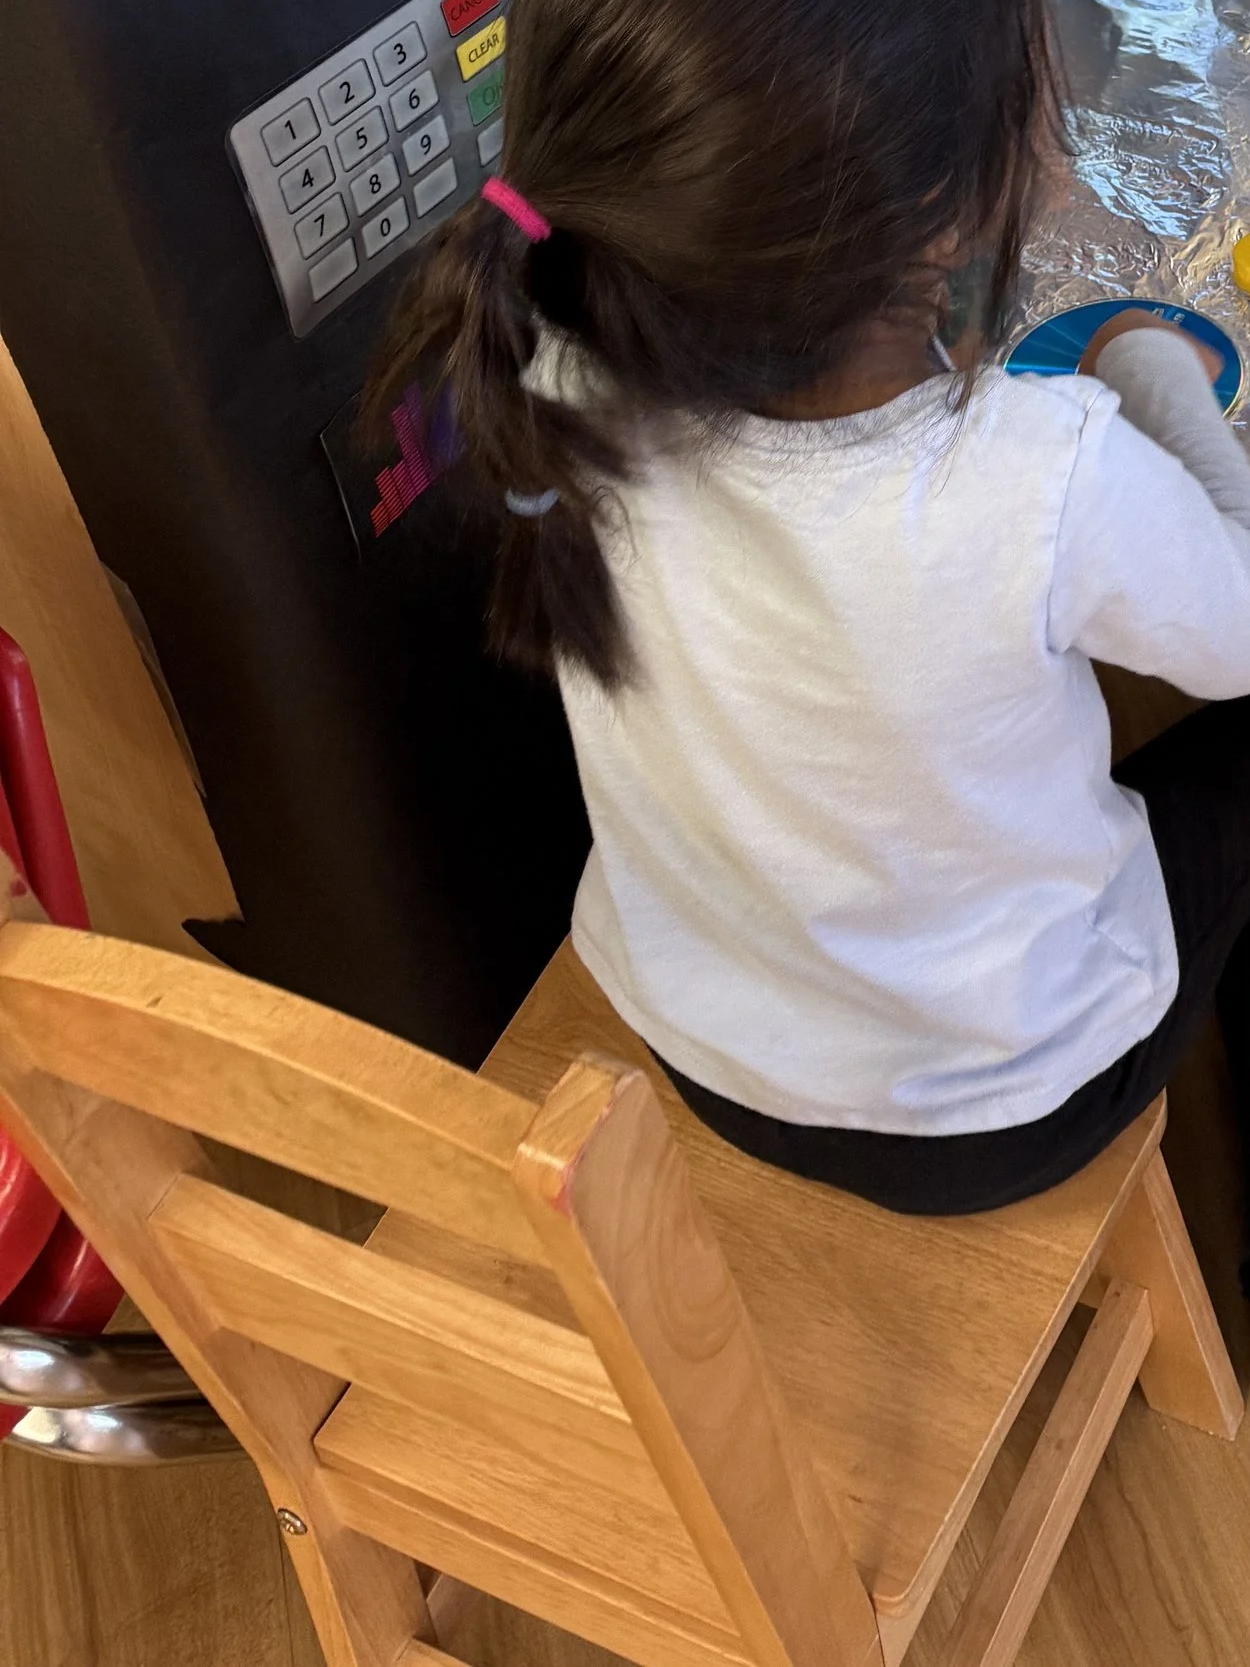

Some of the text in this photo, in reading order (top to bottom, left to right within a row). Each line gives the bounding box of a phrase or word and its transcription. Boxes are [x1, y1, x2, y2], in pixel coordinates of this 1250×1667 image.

[393, 43, 407, 65] 3
[468, 33, 500, 64] CLEAR
[339, 81, 355, 104] 2
[408, 88, 421, 109] 6
[284, 120, 297, 140] 1
[356, 127, 368, 150] 5
[420, 134, 432, 155] 9
[301, 168, 314, 188] 4
[369, 174, 382, 195] 8
[313, 213, 325, 237] 7
[380, 218, 391, 237] 0
